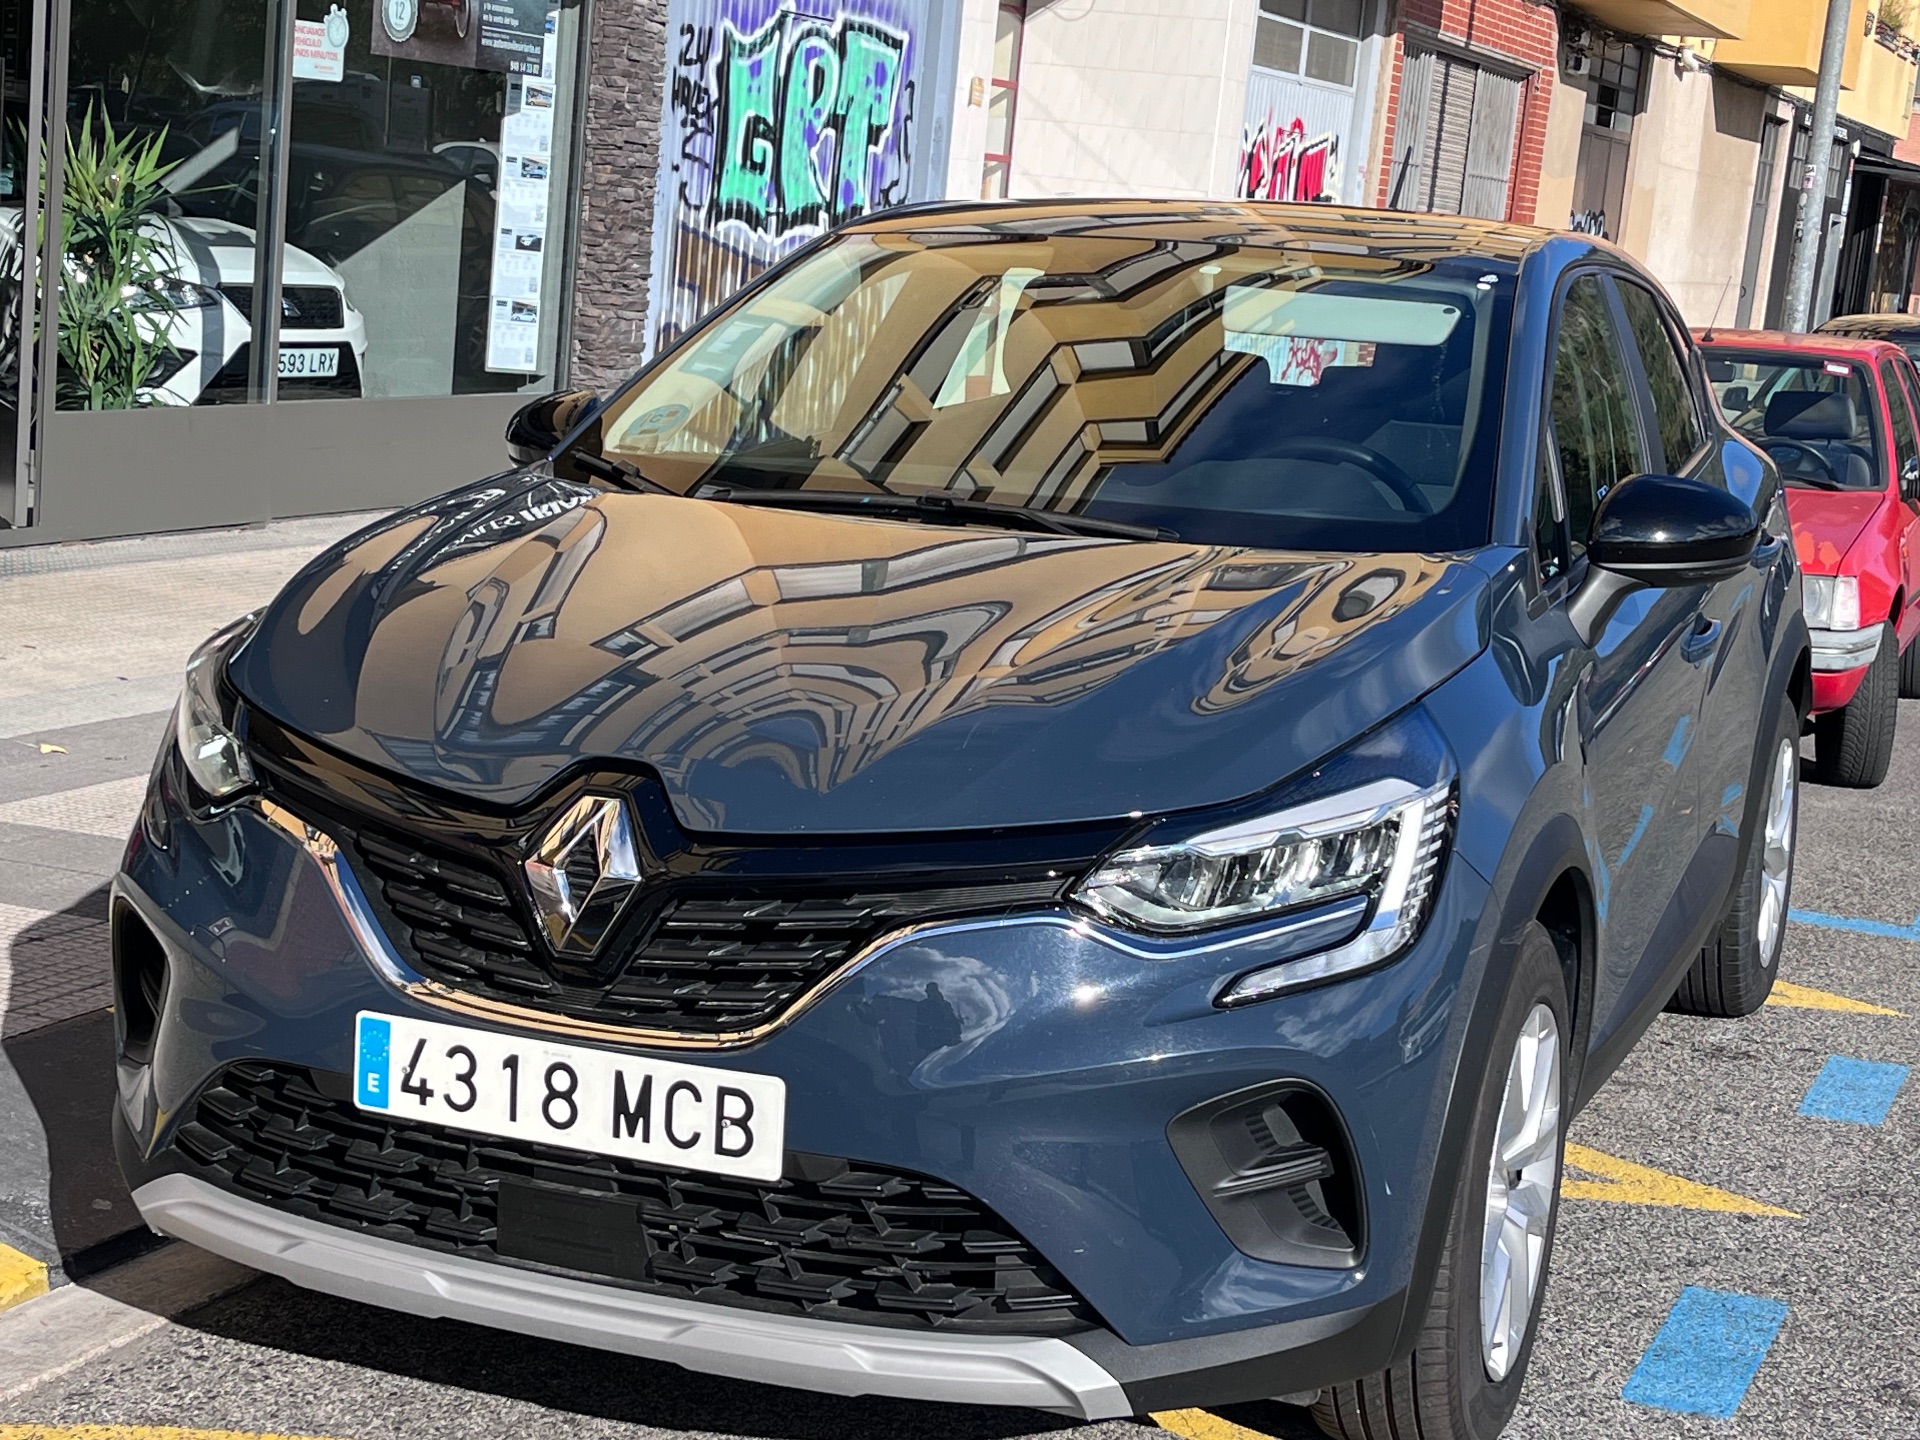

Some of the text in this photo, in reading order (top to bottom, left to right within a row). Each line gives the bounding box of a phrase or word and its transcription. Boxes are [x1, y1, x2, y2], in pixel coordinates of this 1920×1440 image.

[278, 352, 336, 374] 593 LRX
[367, 1072, 380, 1094] E
[400, 1037, 755, 1159] 4318 MCB
